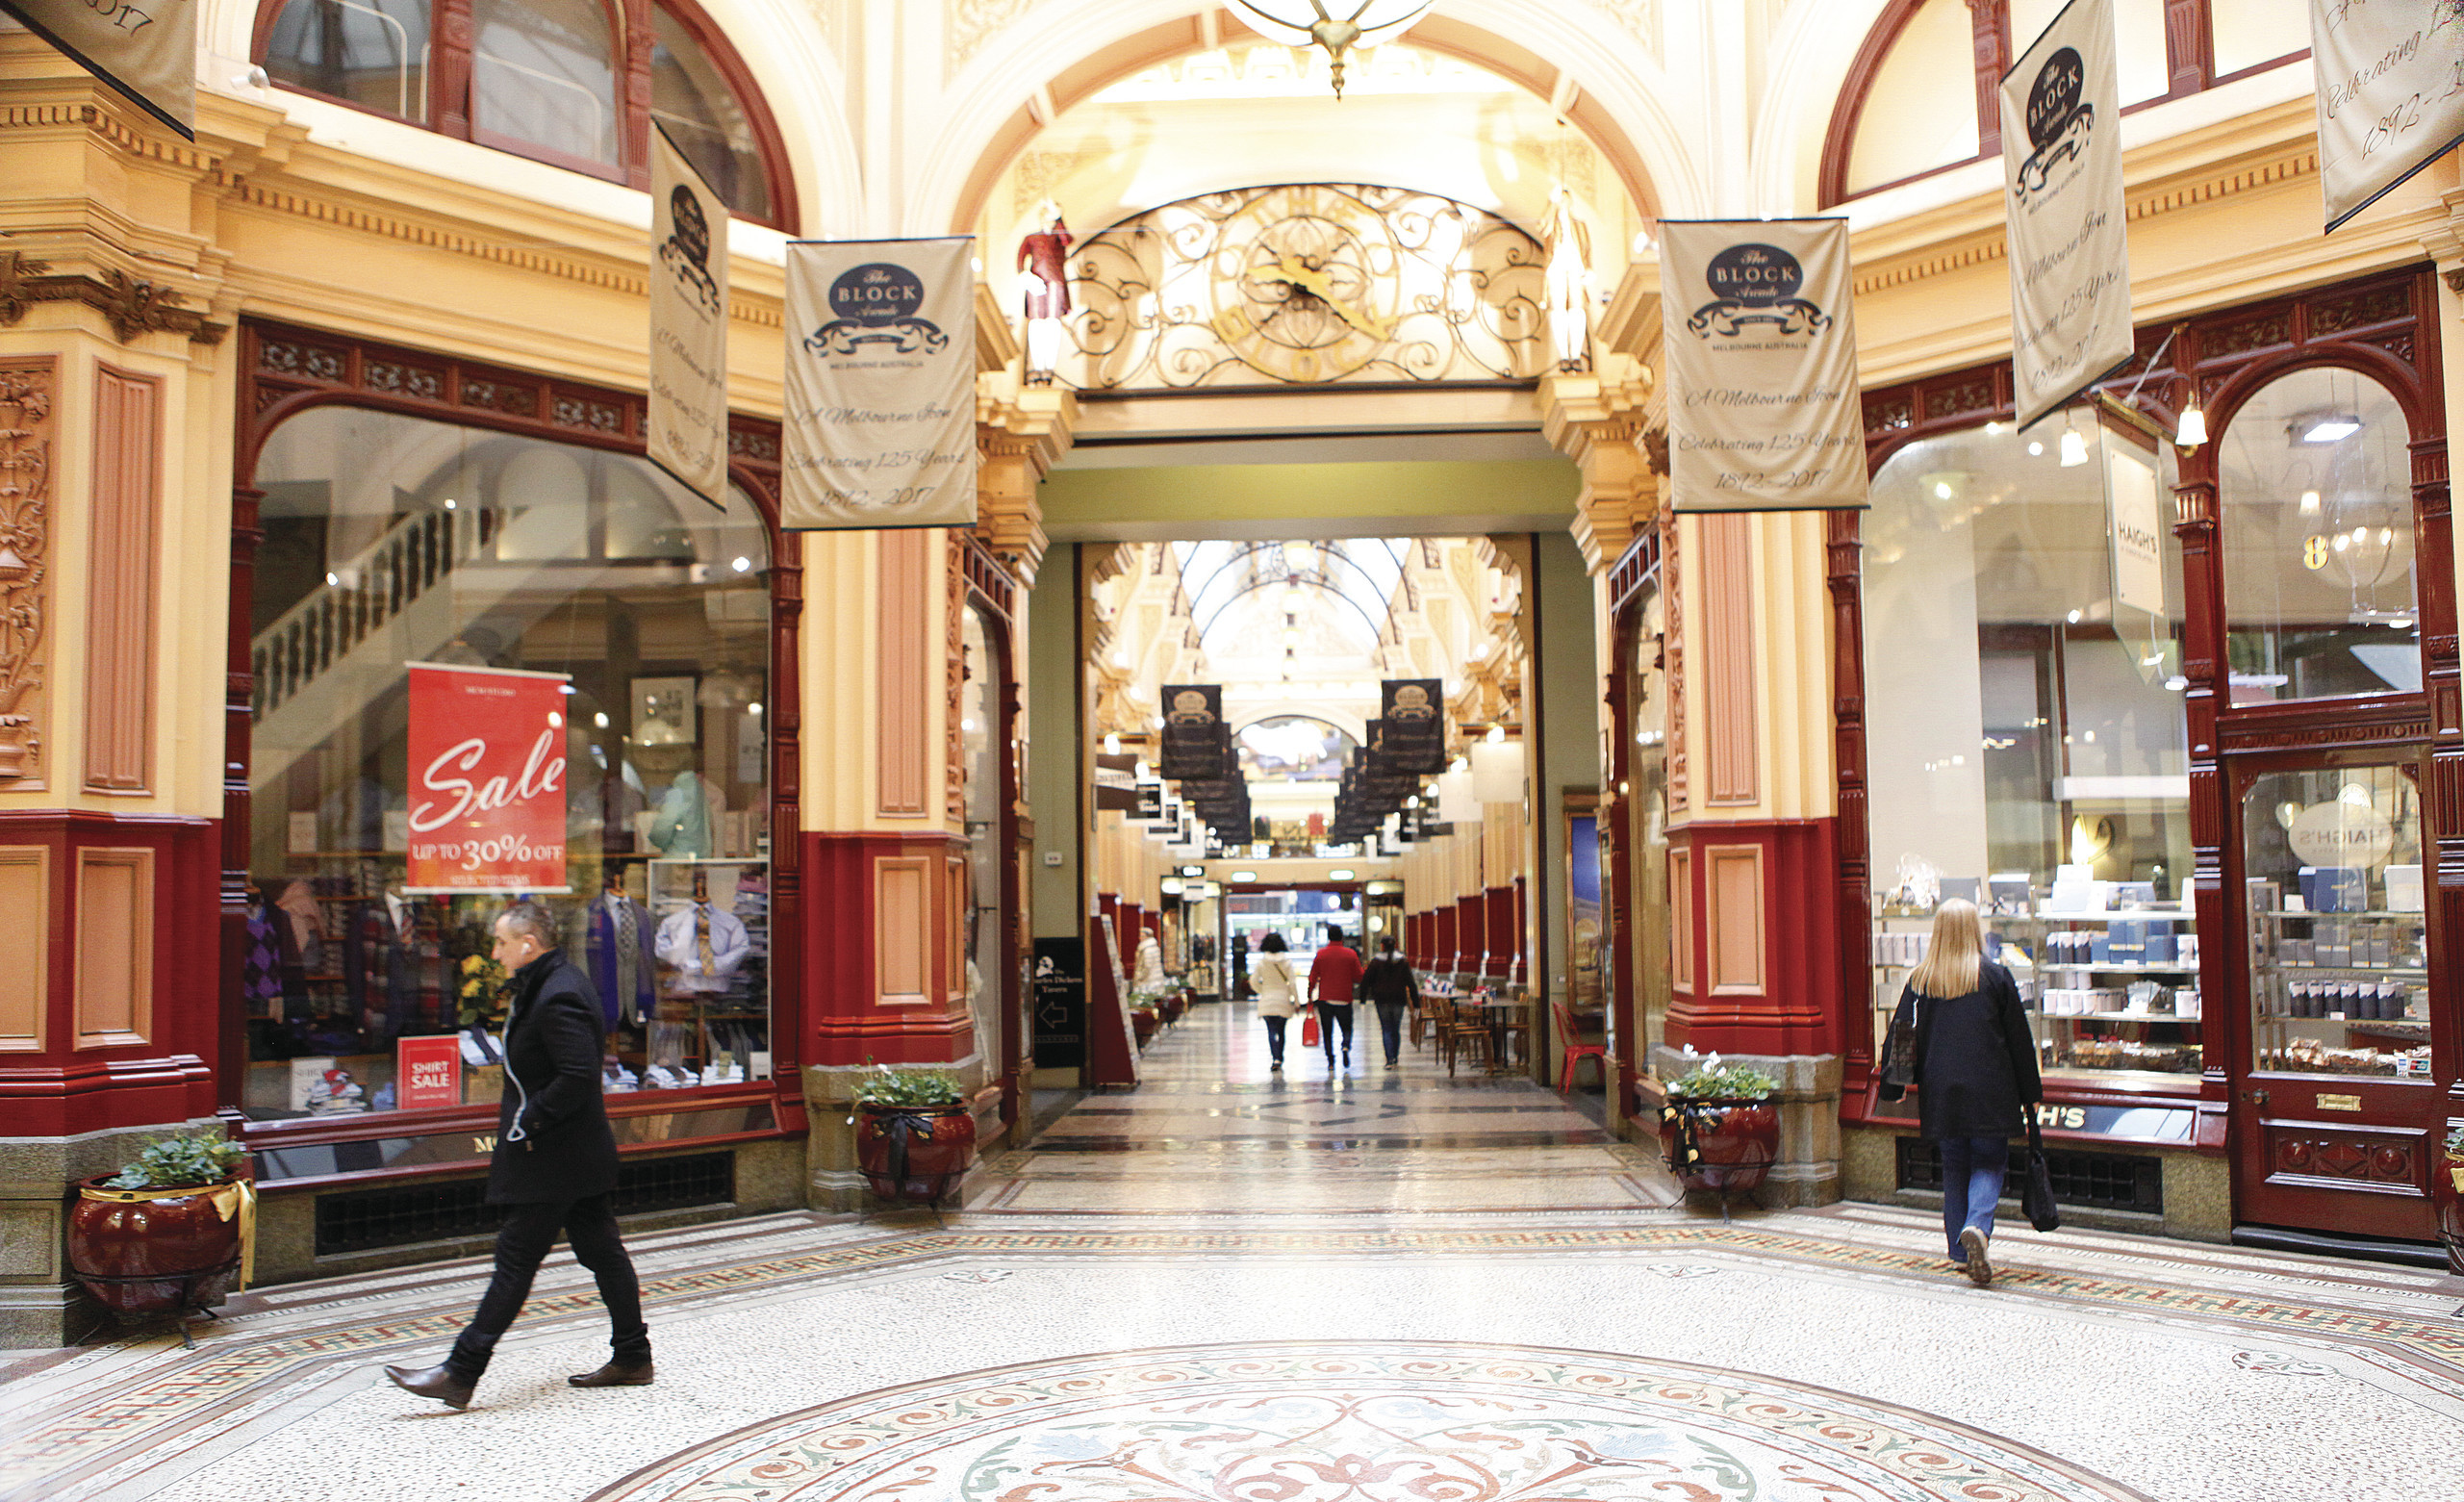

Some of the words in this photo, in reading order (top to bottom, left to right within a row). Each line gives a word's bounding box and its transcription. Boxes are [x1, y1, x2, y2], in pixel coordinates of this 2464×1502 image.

[84, 0, 154, 37] 017
[2327, 31, 2421, 119] Celebrating
[2029, 64, 2080, 128] BLOCK
[2362, 92, 2422, 161] 1892
[1740, 249, 1769, 266] The
[1715, 266, 1795, 283] BLOCK
[838, 285, 917, 302] BLOCK
[1686, 389, 1713, 408] A
[1714, 388, 1803, 408] Melbourne
[825, 407, 914, 425] Melbourne
[1679, 434, 1765, 454] Celebrating
[1769, 433, 1805, 451] 125
[875, 449, 913, 469] 125
[881, 486, 936, 505] 2017
[2118, 521, 2158, 555] HAIGH'S
[2303, 535, 2329, 571] 8
[409, 728, 567, 833] Sale
[412, 843, 438, 860] UP
[438, 843, 462, 860] TO
[461, 832, 532, 871] 30%
[532, 844, 565, 861] OFF
[411, 1060, 450, 1075] SHIRT
[411, 1073, 451, 1089] SALE
